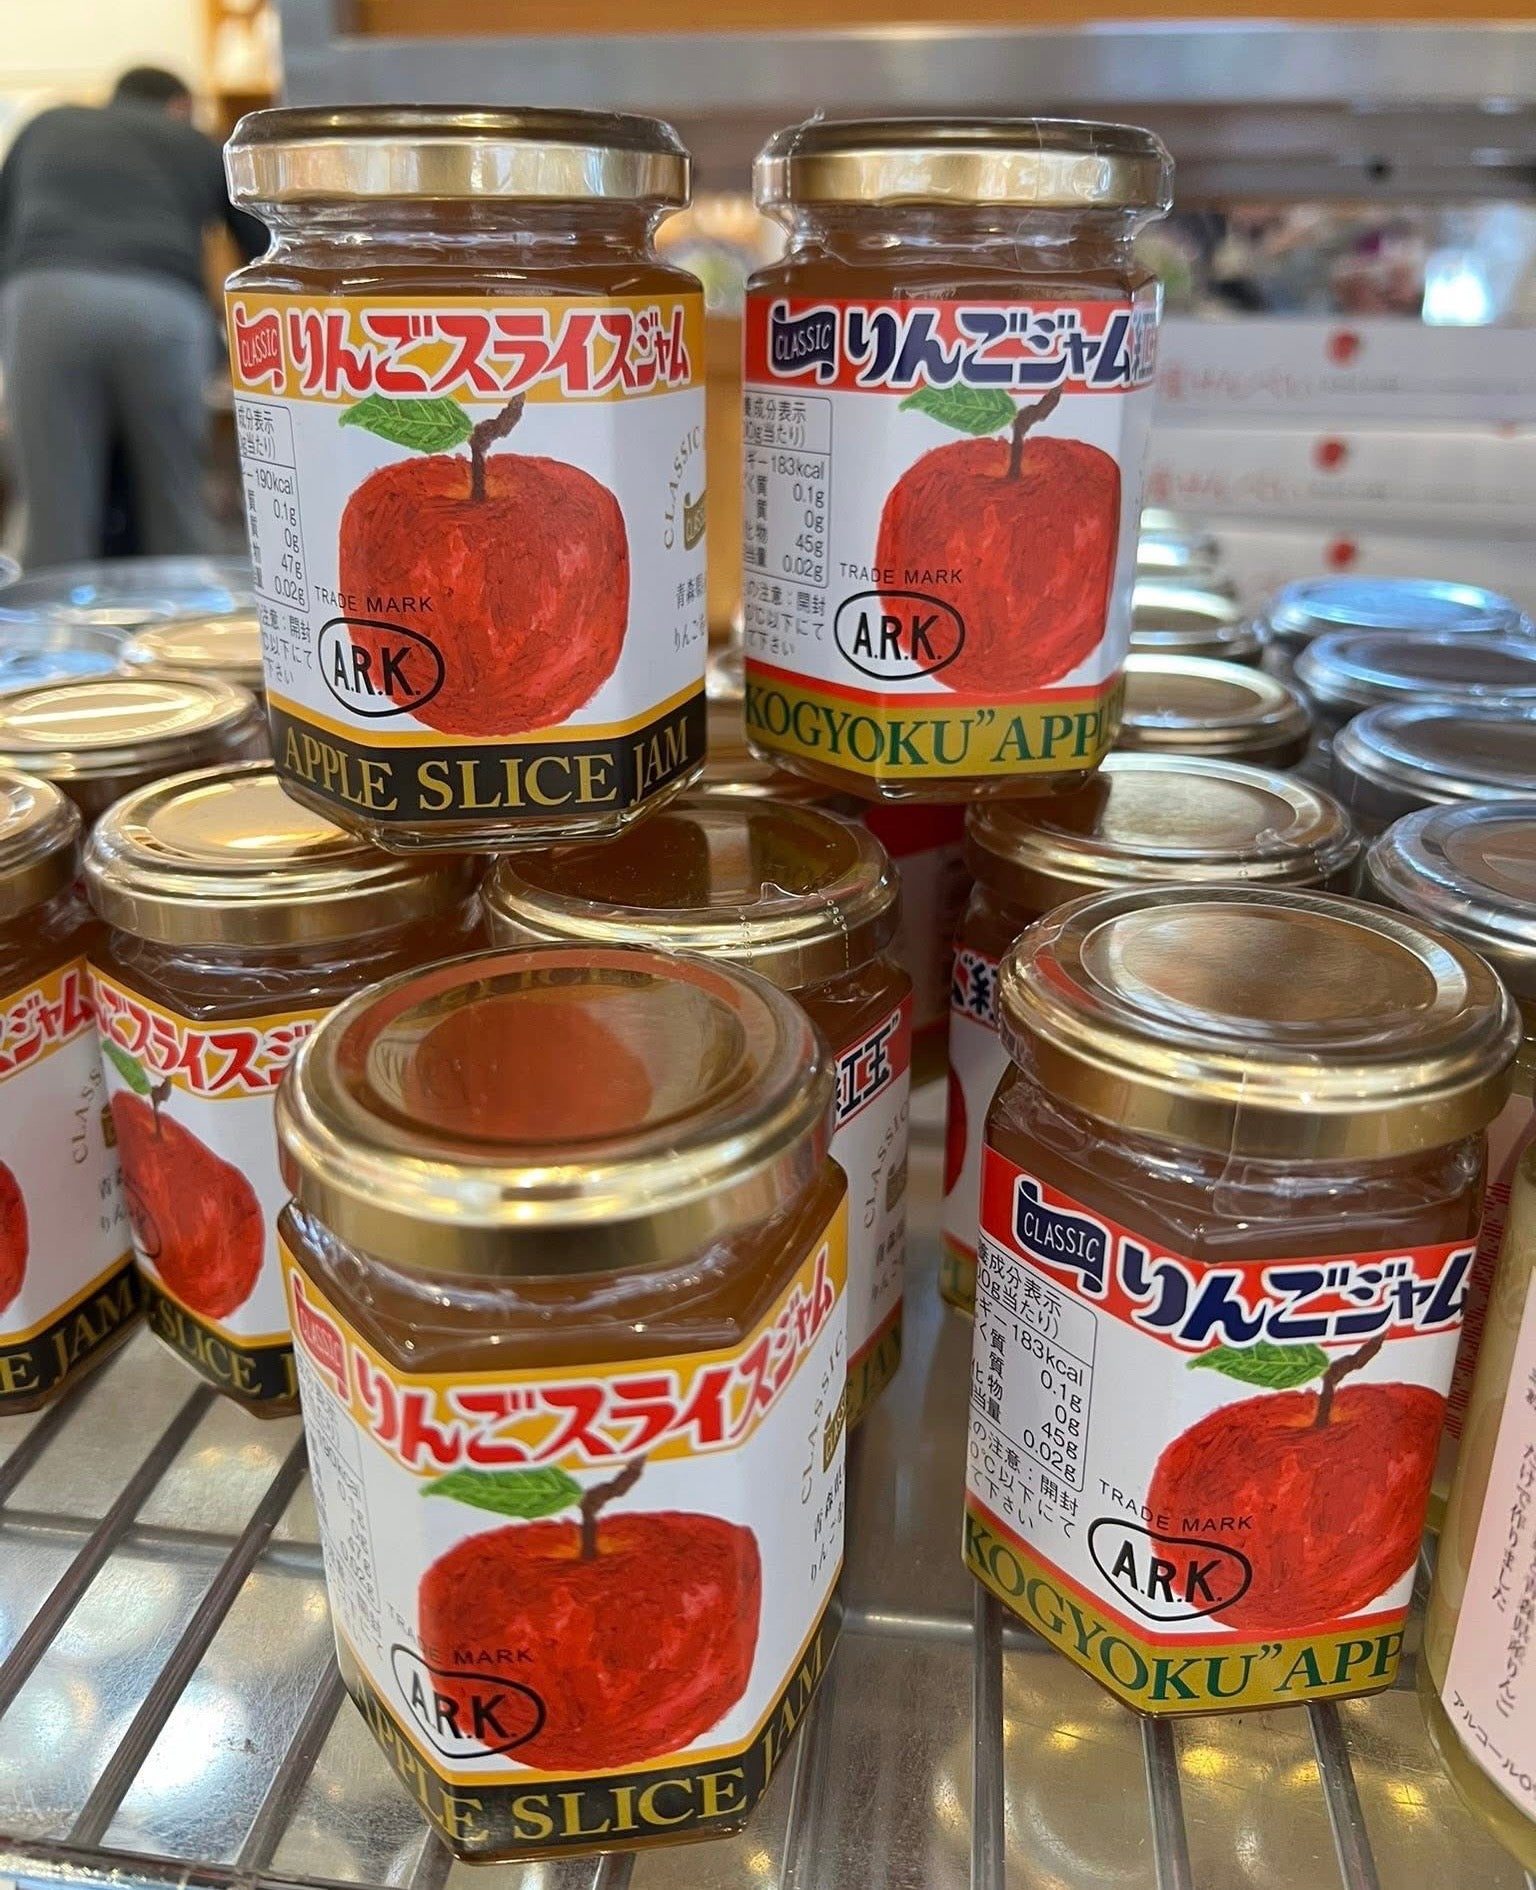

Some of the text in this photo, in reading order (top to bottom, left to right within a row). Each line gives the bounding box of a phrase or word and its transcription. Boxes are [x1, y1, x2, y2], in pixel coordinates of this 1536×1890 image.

[241, 326, 278, 370] CLASSIC
[288, 308, 690, 392] りんごスライスジャム
[776, 323, 832, 362] CLASSIC
[848, 310, 1130, 384] りんごジャム
[256, 469, 294, 495] 190kcal
[771, 455, 825, 480] 183kcal
[273, 498, 297, 526] 0.1g
[792, 483, 825, 509] 0.1g
[284, 527, 300, 553] 0g
[805, 510, 824, 533] 0g
[281, 554, 303, 580] 47g
[795, 534, 824, 558] 45g
[782, 554, 824, 583] 0.02g
[839, 562, 963, 585] TRADE MARK
[274, 575, 306, 607] 0.02g
[314, 585, 434, 614] TRADE MARK
[852, 611, 942, 661] A.R.K.
[333, 640, 421, 697] A.R.K.
[283, 716, 689, 811] APPLE SLICE JAM
[1023, 1211, 1100, 1264] CLASSIC
[1119, 1244, 1473, 1342] りんごジャム
[355, 1248, 834, 1465] りんごスライスジャム
[1012, 1323, 1083, 1387] 183kcal
[1040, 1369, 1083, 1414] 0.1g
[1041, 1418, 1078, 1461] 45g
[1054, 1403, 1081, 1438] 0g
[1023, 1428, 1077, 1484] 0.02g
[1099, 1477, 1254, 1533] TRADE MARK
[1111, 1539, 1223, 1603] A.R.K.
[453, 1648, 534, 1665] MARK
[355, 1634, 826, 1844] APPLE SLICE JAM
